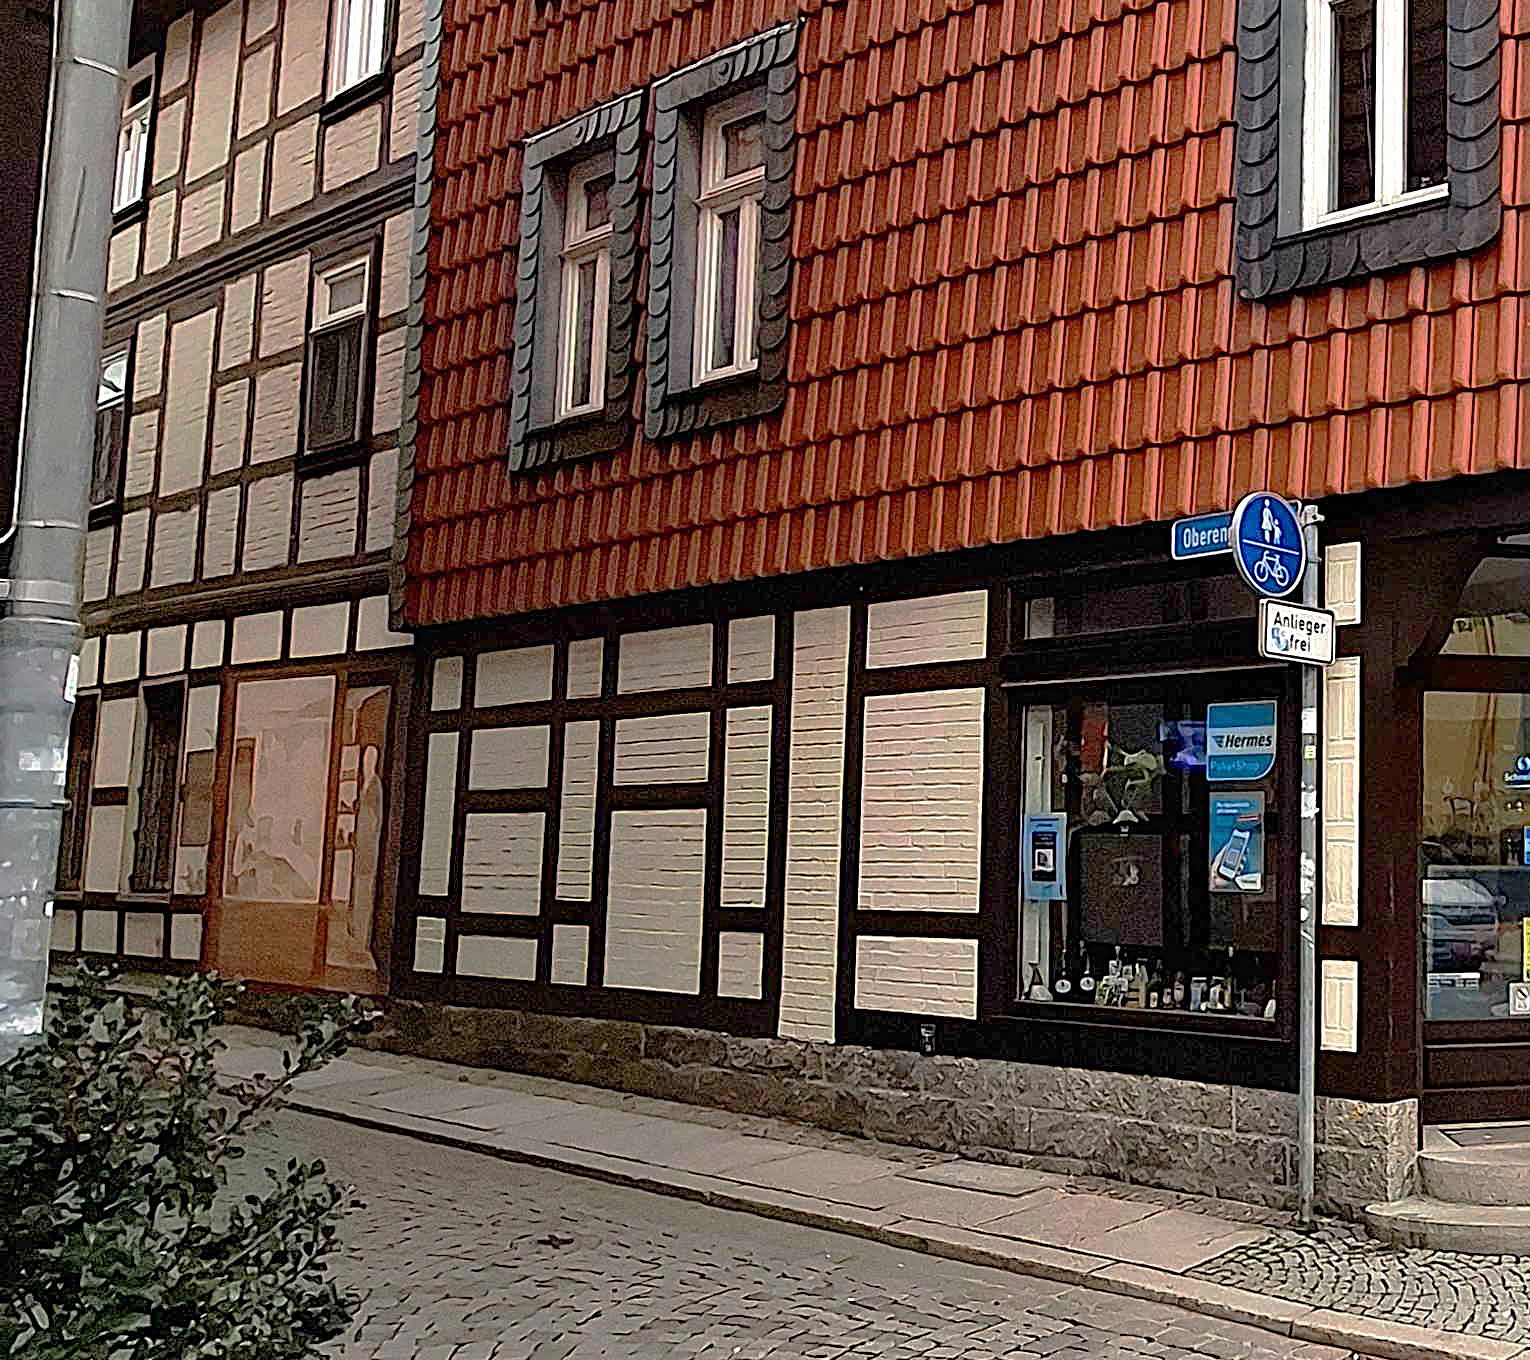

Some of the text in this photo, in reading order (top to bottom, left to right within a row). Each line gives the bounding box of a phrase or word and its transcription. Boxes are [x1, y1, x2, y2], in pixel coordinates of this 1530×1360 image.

[1183, 526, 1233, 549] Oberen
[1273, 611, 1327, 636] Anlieger
[1289, 634, 1311, 652] frei
[1225, 733, 1273, 748] Hermes
